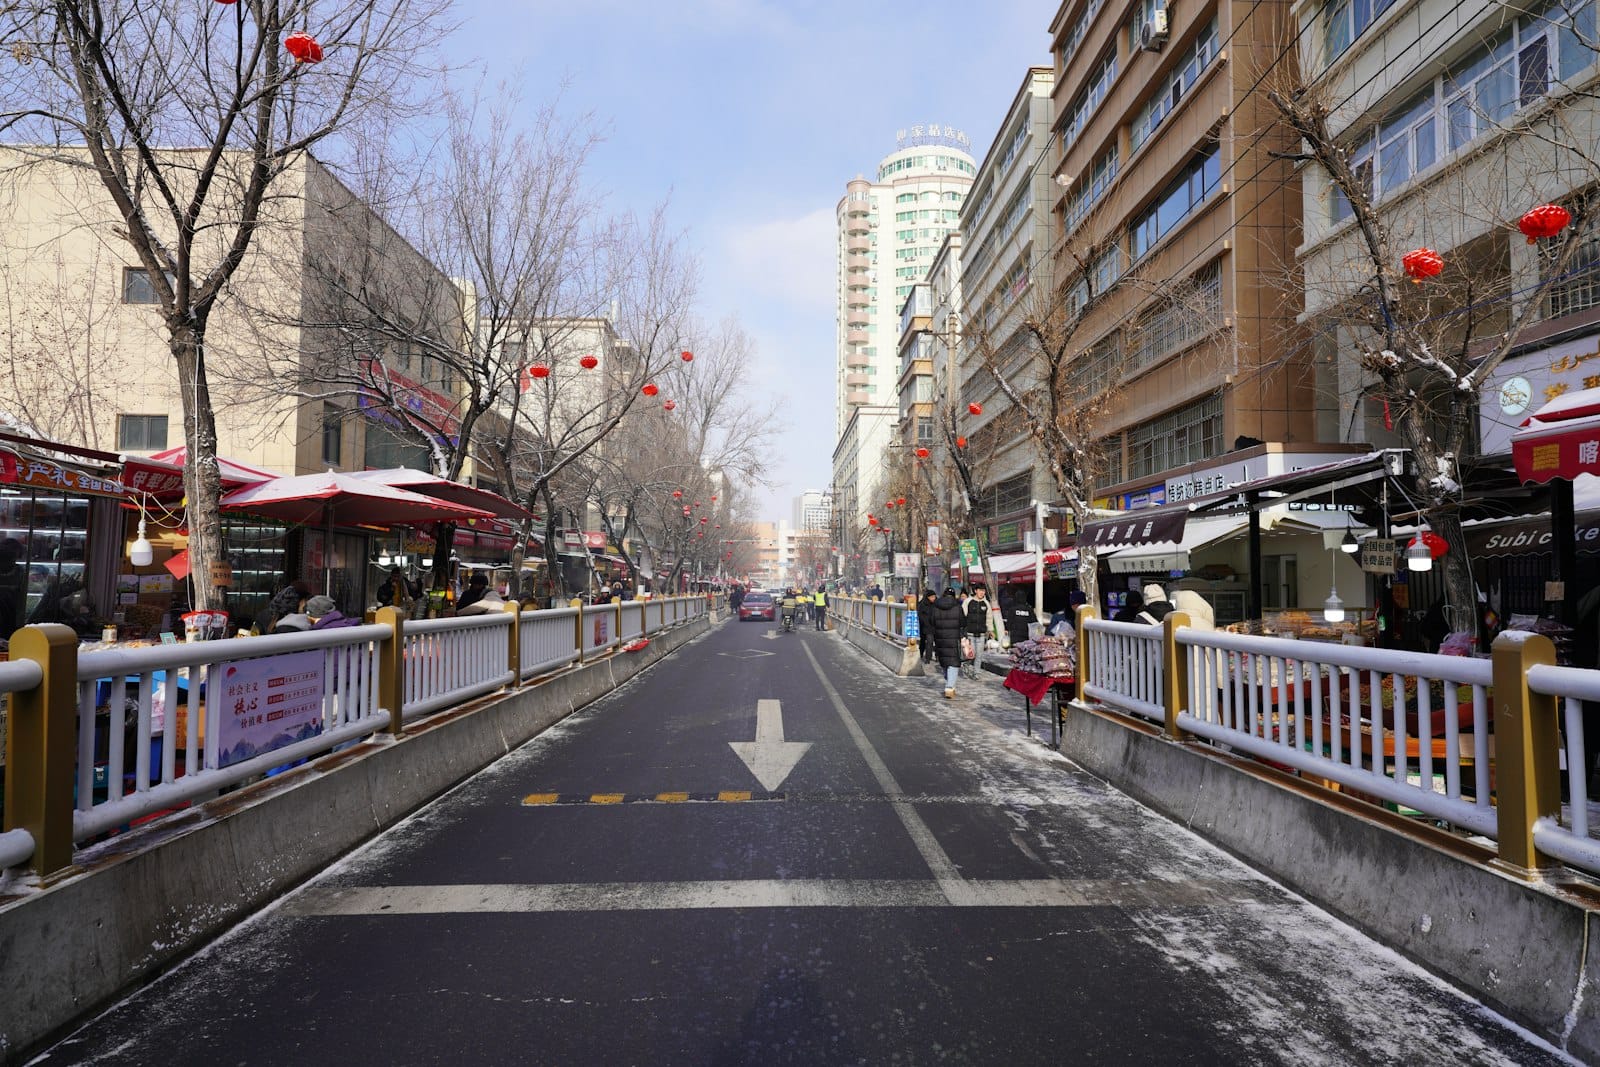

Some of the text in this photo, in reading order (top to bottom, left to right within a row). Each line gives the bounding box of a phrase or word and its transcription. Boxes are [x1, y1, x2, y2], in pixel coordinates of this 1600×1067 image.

[1579, 440, 1599, 465] 喀
[1539, 524, 1600, 545] cke
[228, 682, 258, 696] 社会主义
